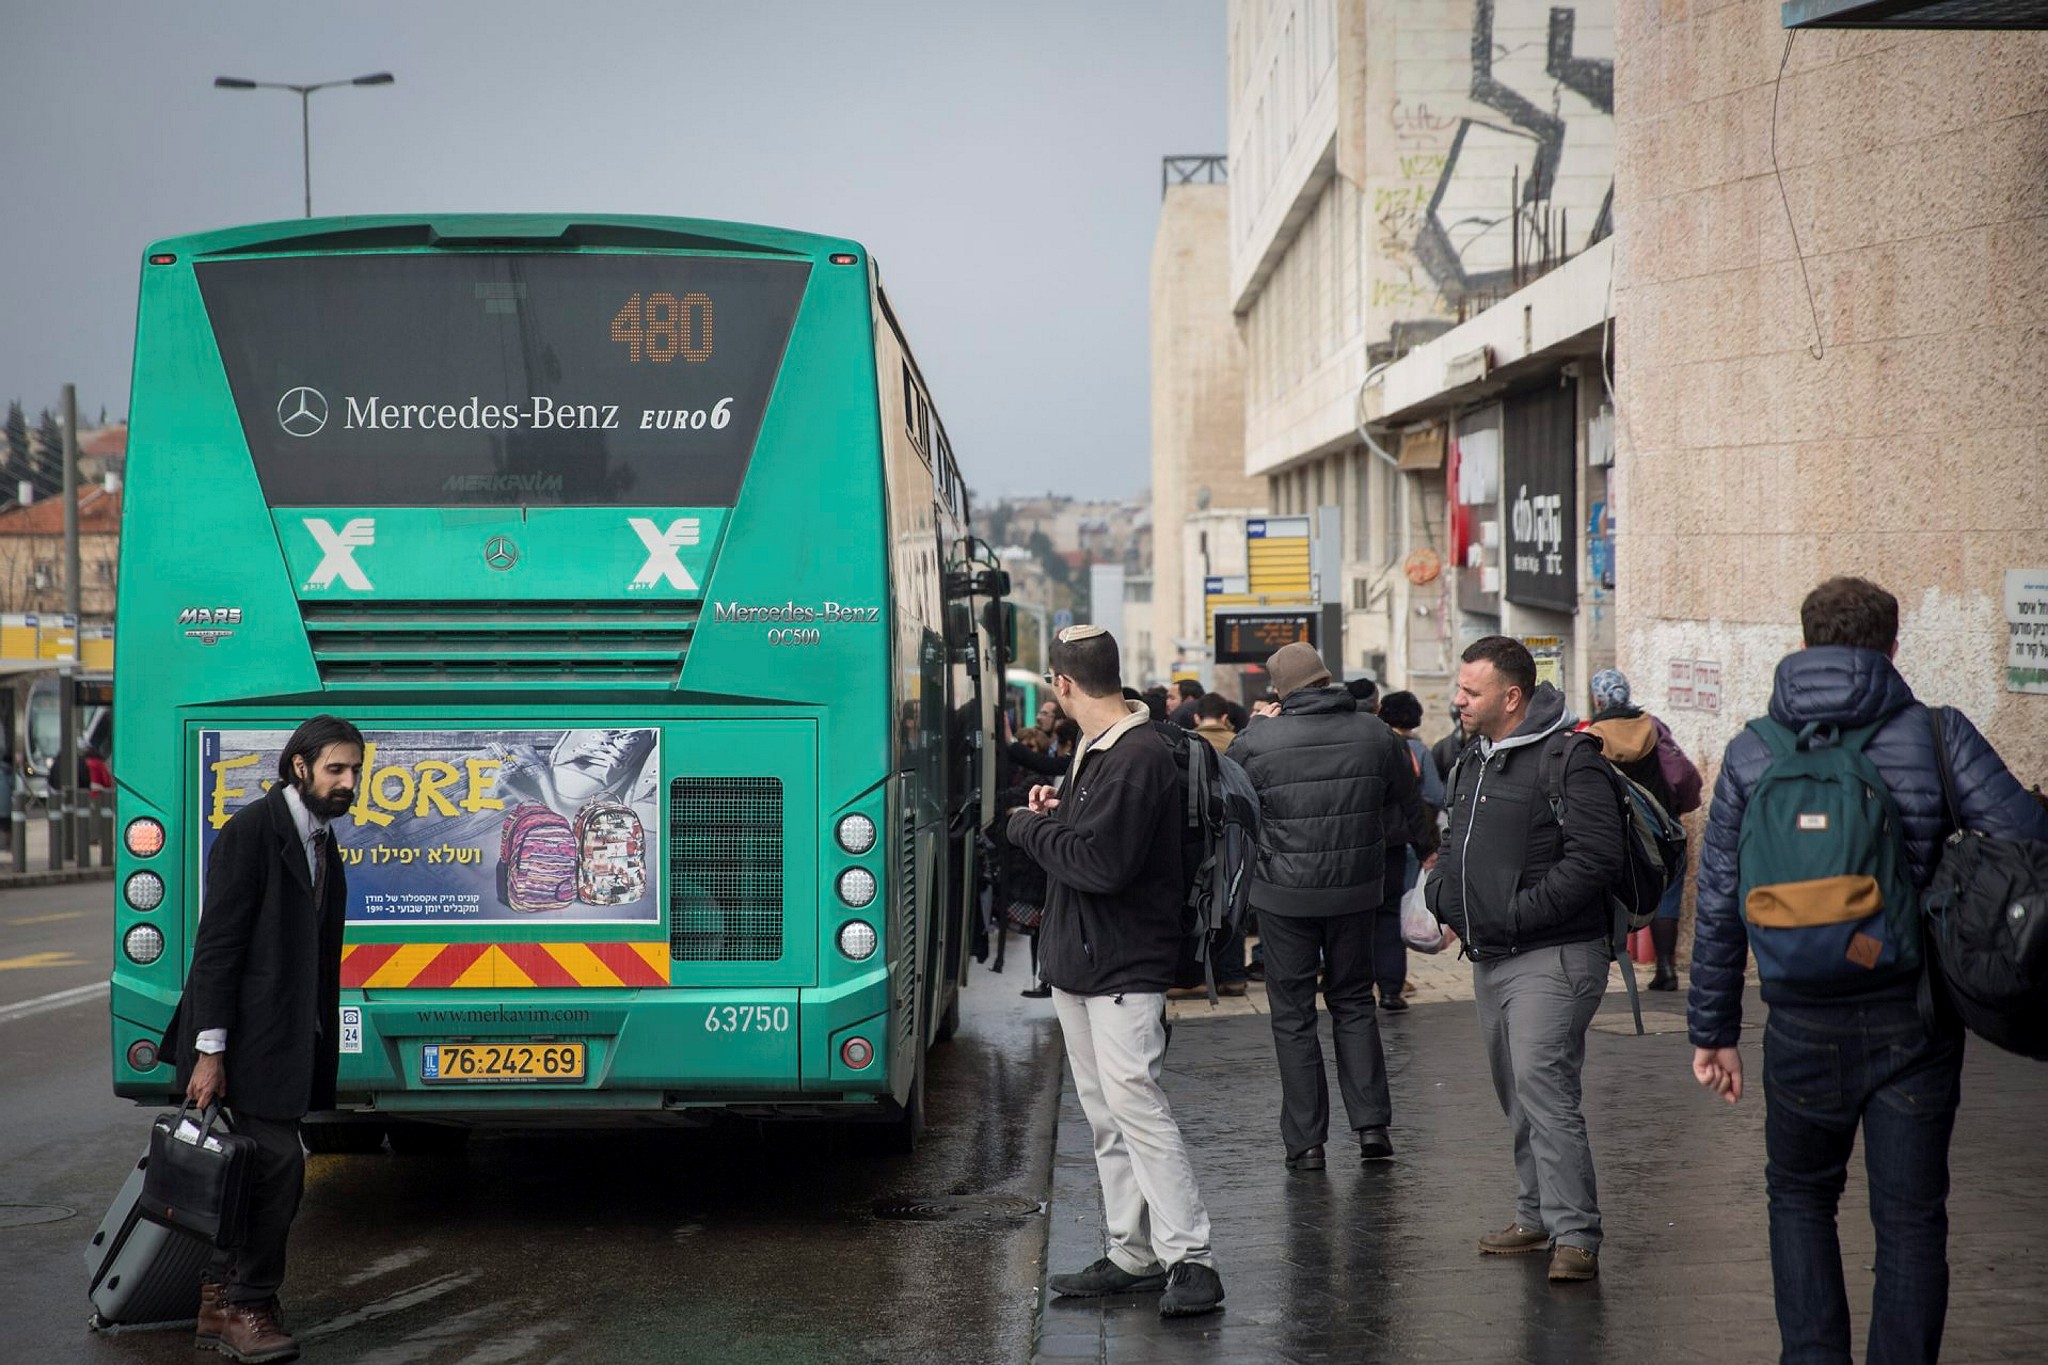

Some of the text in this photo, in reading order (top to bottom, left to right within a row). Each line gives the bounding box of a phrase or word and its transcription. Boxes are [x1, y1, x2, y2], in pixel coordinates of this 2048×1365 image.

[611, 292, 713, 362] 480
[344, 396, 620, 429] Mercedes-Benz
[179, 608, 241, 624] MARS
[714, 601, 879, 623] Mercedes-Benz
[768, 628, 821, 647] OC500
[207, 742, 505, 830] ELORE
[370, 844, 420, 864] יפילו
[428, 843, 482, 864] ושלא
[385, 893, 399, 902] של
[440, 894, 456, 903] תיק
[458, 894, 480, 903] קונים
[398, 904, 423, 913] שבועי
[425, 904, 441, 914] יומן
[443, 903, 479, 914] ומקבלים
[417, 1004, 590, 1024] www.merkavim.com
[705, 1006, 789, 1032] 63750
[345, 1029, 358, 1041] 24
[426, 1055, 436, 1068] IL
